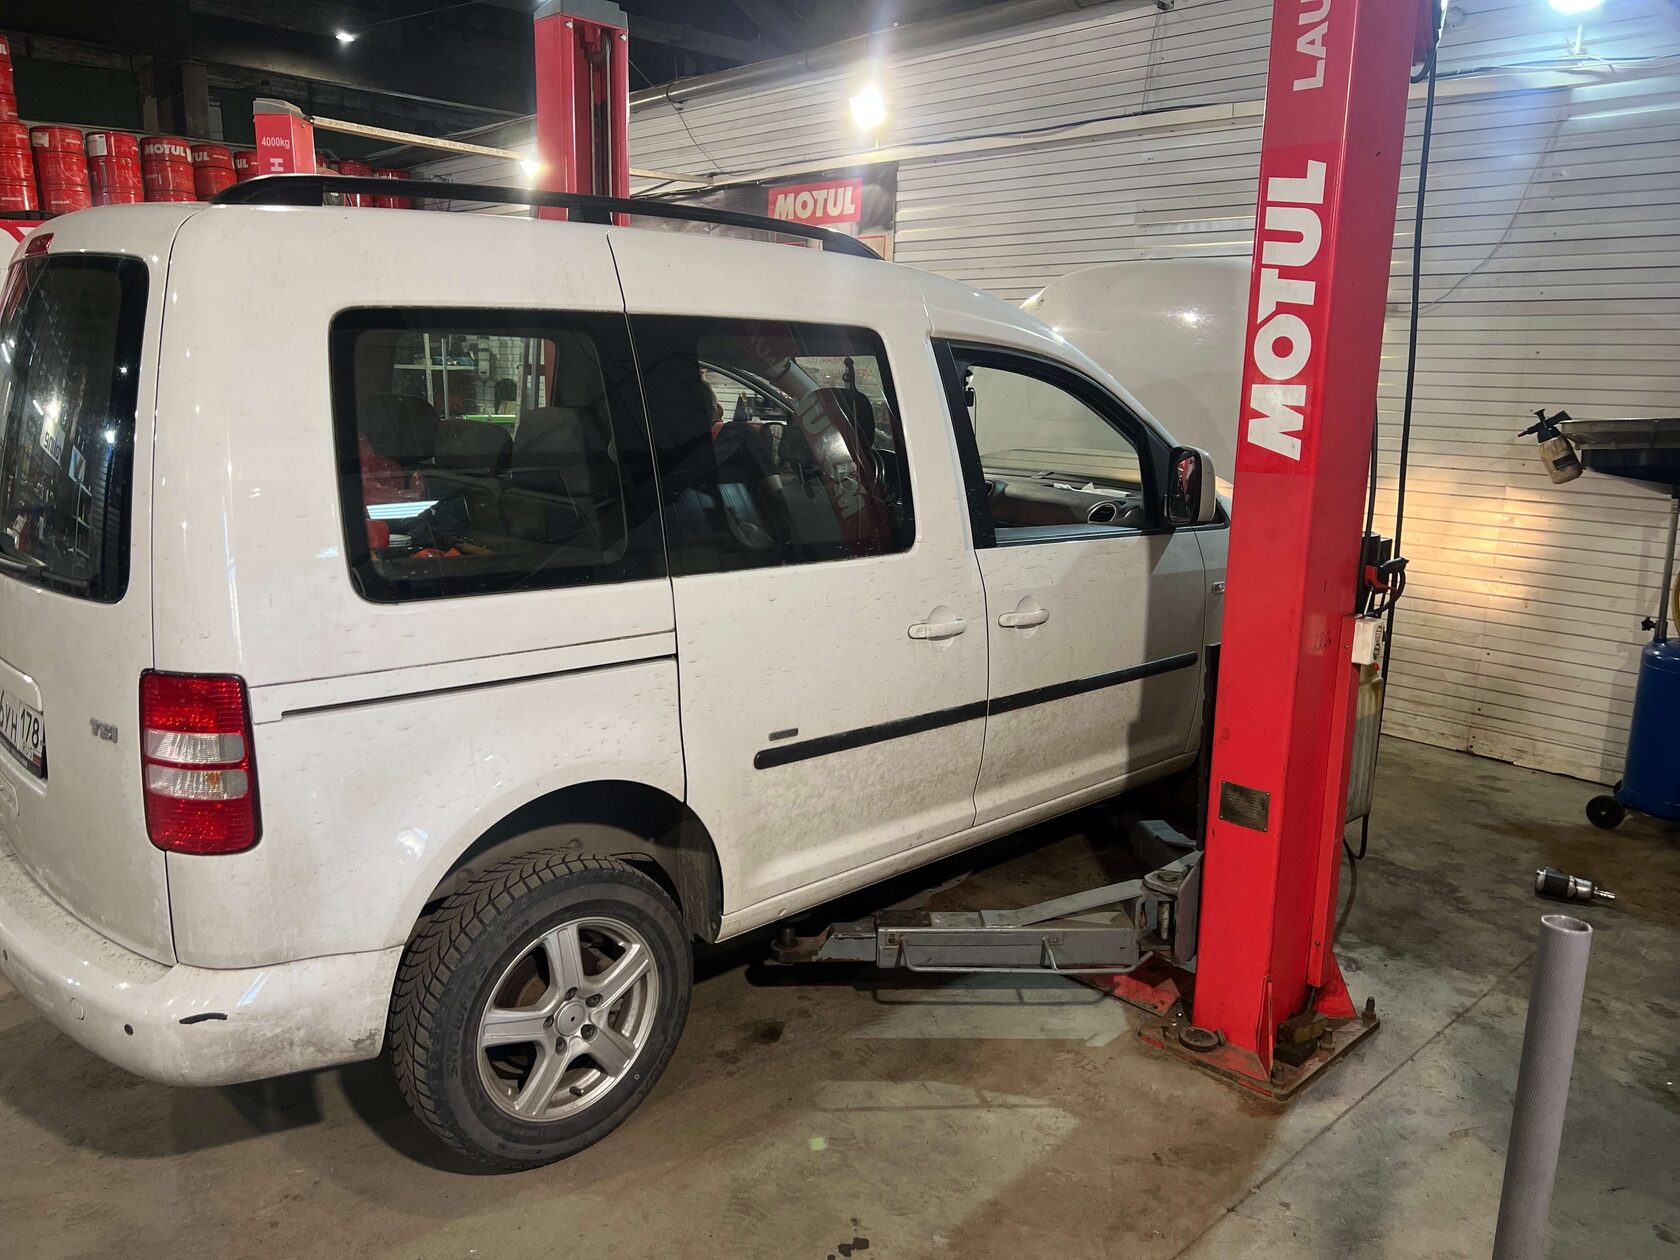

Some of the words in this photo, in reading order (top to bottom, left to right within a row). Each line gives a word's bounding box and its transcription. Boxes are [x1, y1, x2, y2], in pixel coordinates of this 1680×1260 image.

[144, 143, 186, 157] MOTUL
[261, 136, 290, 149] 4000kg
[773, 186, 856, 220] MOTUL
[1247, 159, 1327, 462] MOTUL
[20, 708, 40, 748] 178
